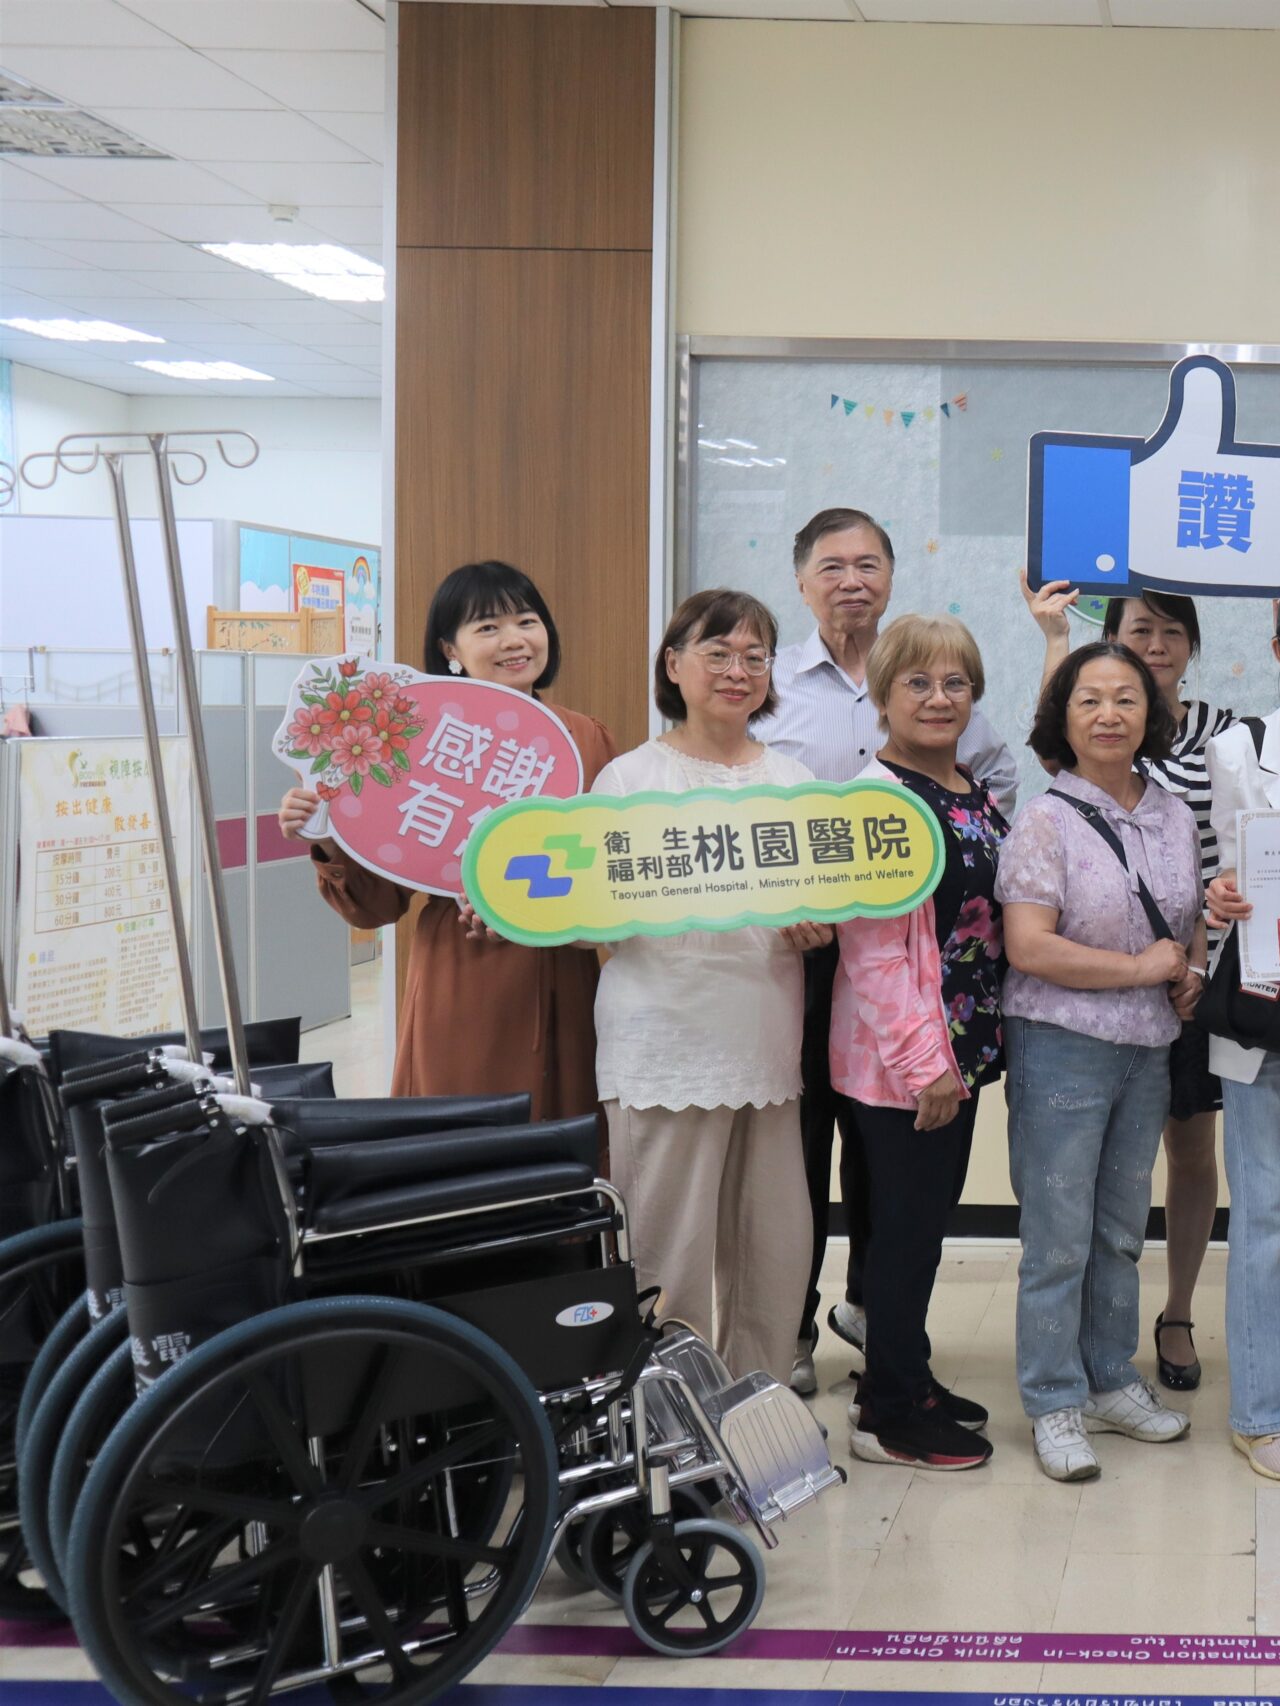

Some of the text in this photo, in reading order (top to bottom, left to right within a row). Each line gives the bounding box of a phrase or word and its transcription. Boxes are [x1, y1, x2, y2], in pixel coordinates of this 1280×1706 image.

[1178, 470, 1255, 553] 讚
[419, 713, 556, 802] 感謝
[398, 779, 493, 857] 有
[692, 814, 911, 873] 桃園醫院
[607, 854, 693, 883] 福利部
[611, 889, 657, 900] Taoyuan
[661, 884, 702, 897] General
[759, 877, 800, 889] Ministry
[804, 875, 814, 886] of
[818, 873, 851, 884] Health
[855, 871, 872, 882] and
[876, 868, 914, 880] Welfare
[835, 1646, 943, 1657] Check-in
[954, 1648, 1020, 1658] Klinik
[1043, 1649, 1150, 1660] Check-in
